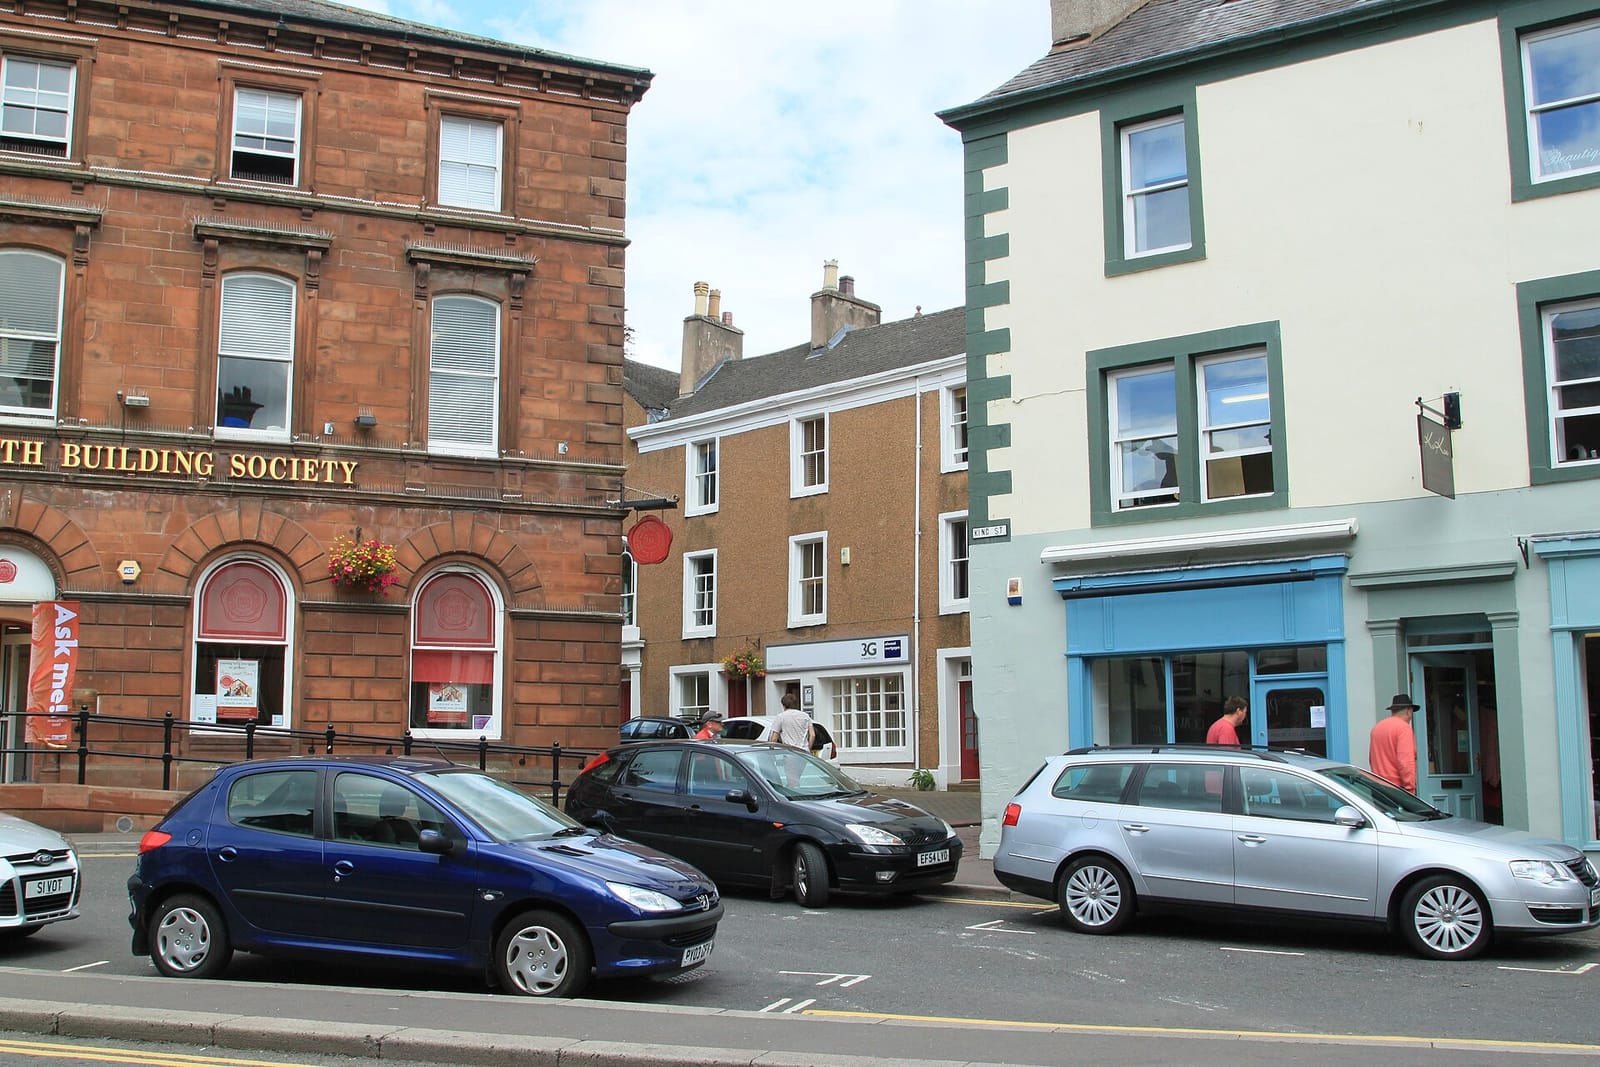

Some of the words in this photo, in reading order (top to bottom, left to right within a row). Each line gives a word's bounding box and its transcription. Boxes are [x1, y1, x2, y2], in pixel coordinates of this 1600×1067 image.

[0, 439, 44, 466] TH
[61, 443, 214, 476] BUILDING
[230, 453, 358, 484] SOCIETY
[54, 603, 78, 657] Ask
[861, 642, 877, 657] 3G
[49, 663, 69, 714] me!
